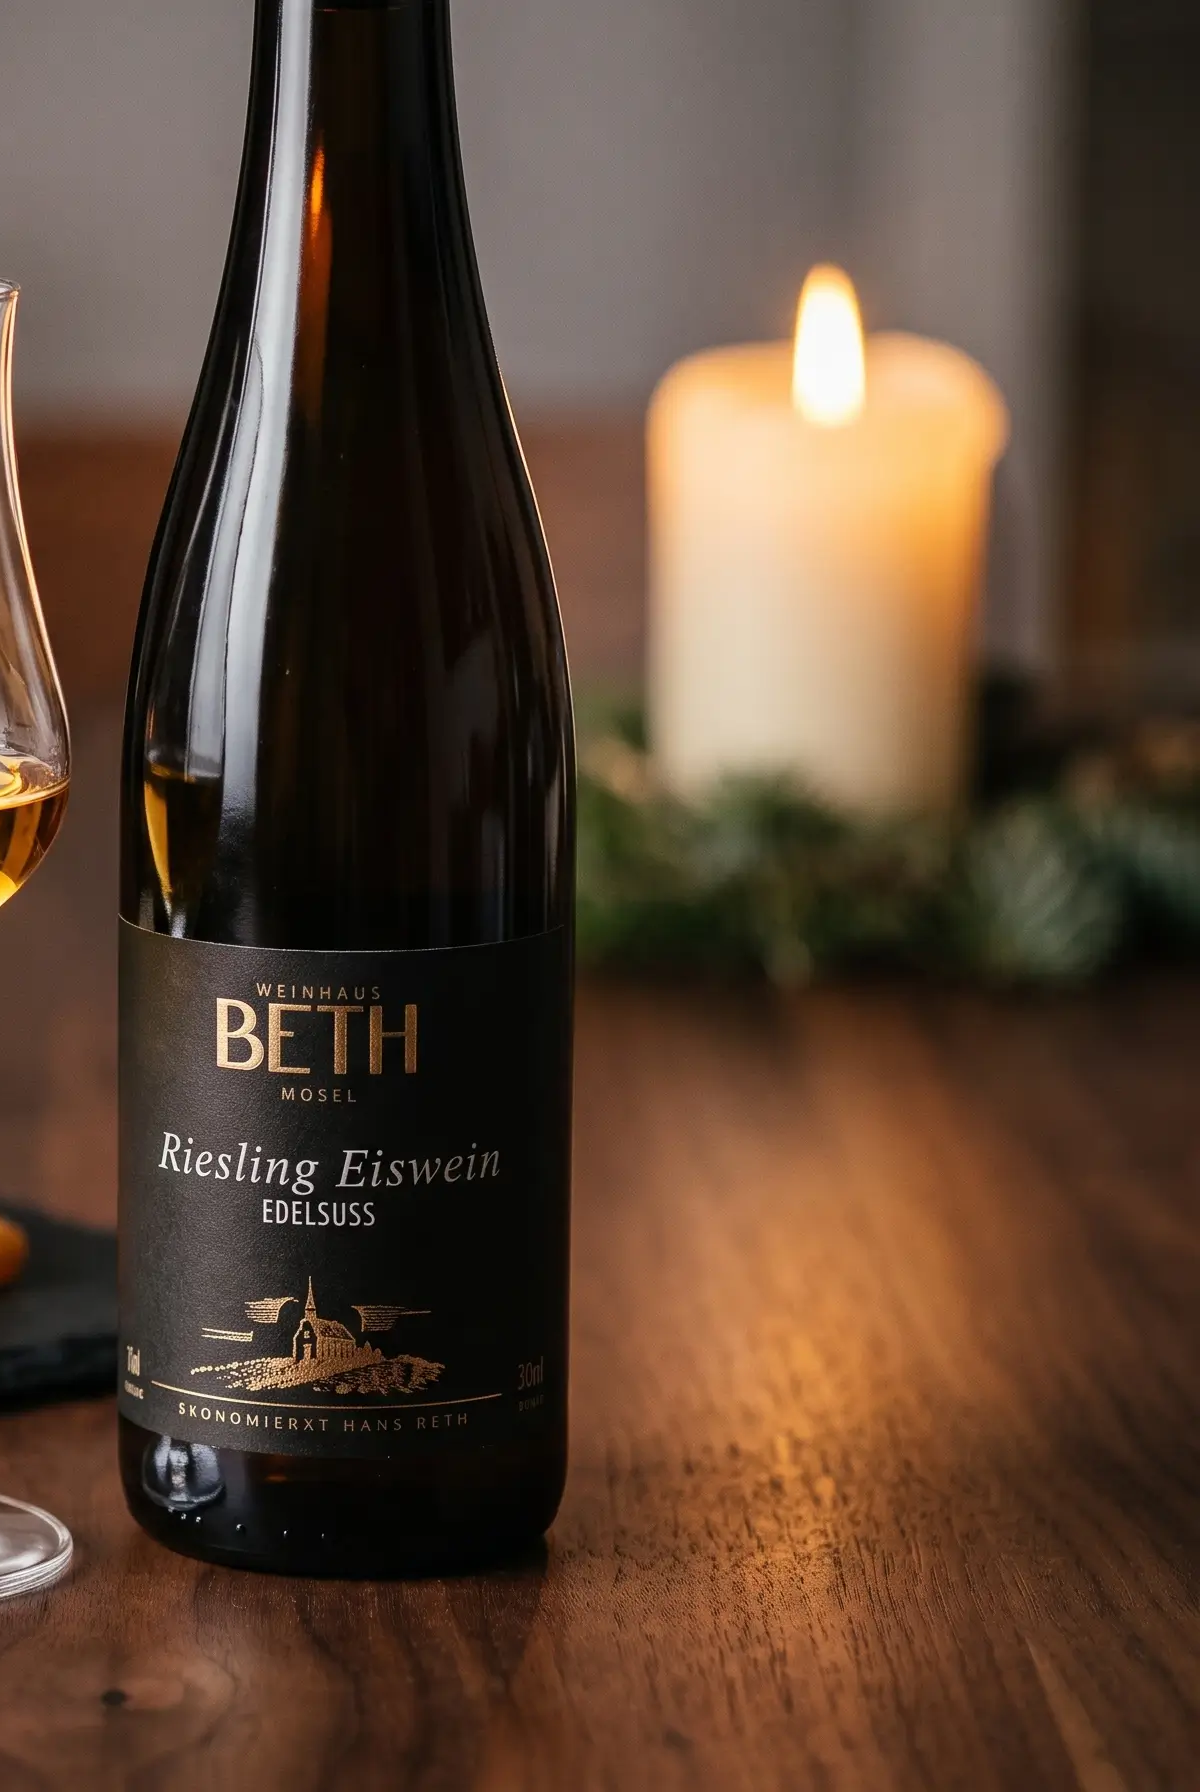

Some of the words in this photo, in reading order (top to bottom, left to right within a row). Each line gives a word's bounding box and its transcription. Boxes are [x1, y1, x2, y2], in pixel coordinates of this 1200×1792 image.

[256, 982, 381, 1000] WEINHAUS
[215, 997, 417, 1074] BETH
[281, 1087, 357, 1103] MOSEL
[158, 1131, 319, 1195] Riesling
[335, 1142, 500, 1188] Eiswein
[262, 1199, 376, 1227] EDELSUSS
[178, 1402, 329, 1432] SKONOMIERXT
[343, 1416, 403, 1432] HANS
[416, 1412, 469, 1431] RETH
